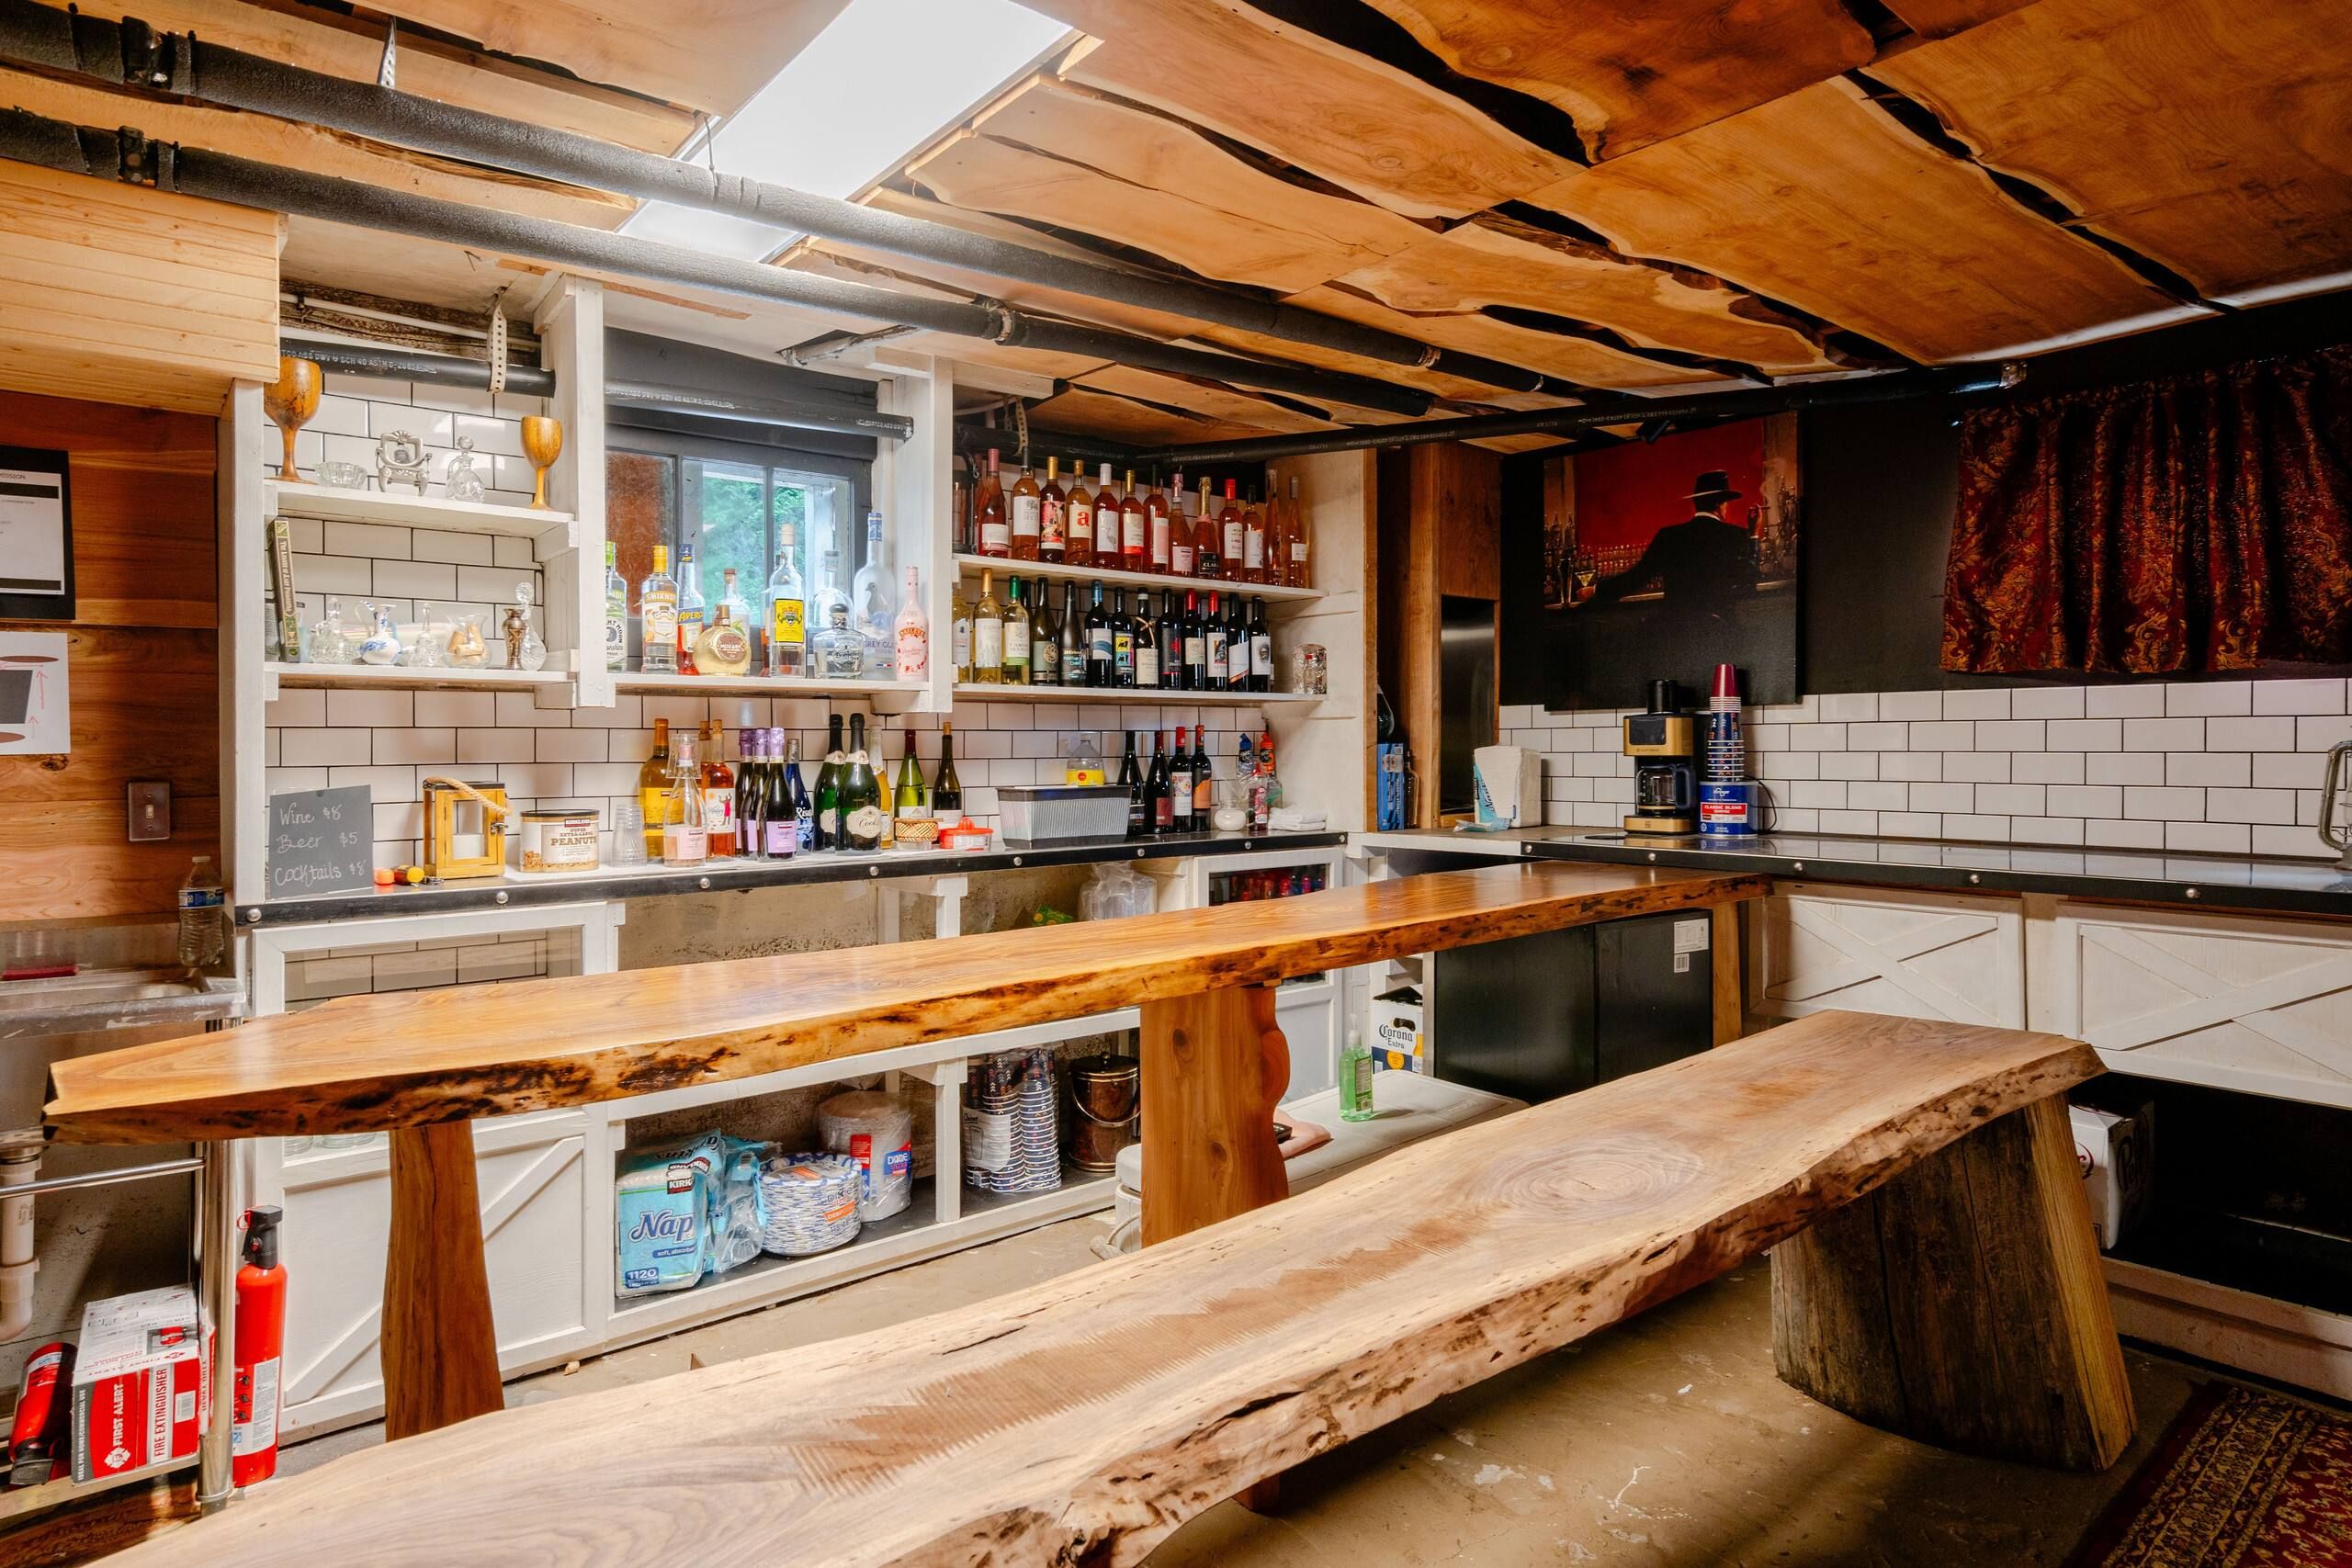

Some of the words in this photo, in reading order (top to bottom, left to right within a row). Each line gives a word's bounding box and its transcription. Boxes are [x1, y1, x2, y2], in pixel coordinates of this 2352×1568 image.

[1077, 511, 1091, 527] a
[280, 802, 315, 825] Wine
[323, 805, 342, 820] $8
[277, 834, 323, 853] Beer
[339, 830, 358, 847] $5
[349, 860, 367, 875] $8
[1378, 1023, 1413, 1043] Corona
[1387, 1037, 1405, 1049] Extra
[628, 1269, 657, 1280] 1120
[113, 1383, 124, 1415] ALERT
[154, 1368, 168, 1435] EXTINGUISHER
[113, 1417, 124, 1447] FIRST
[154, 1436, 165, 1457] FIRE
